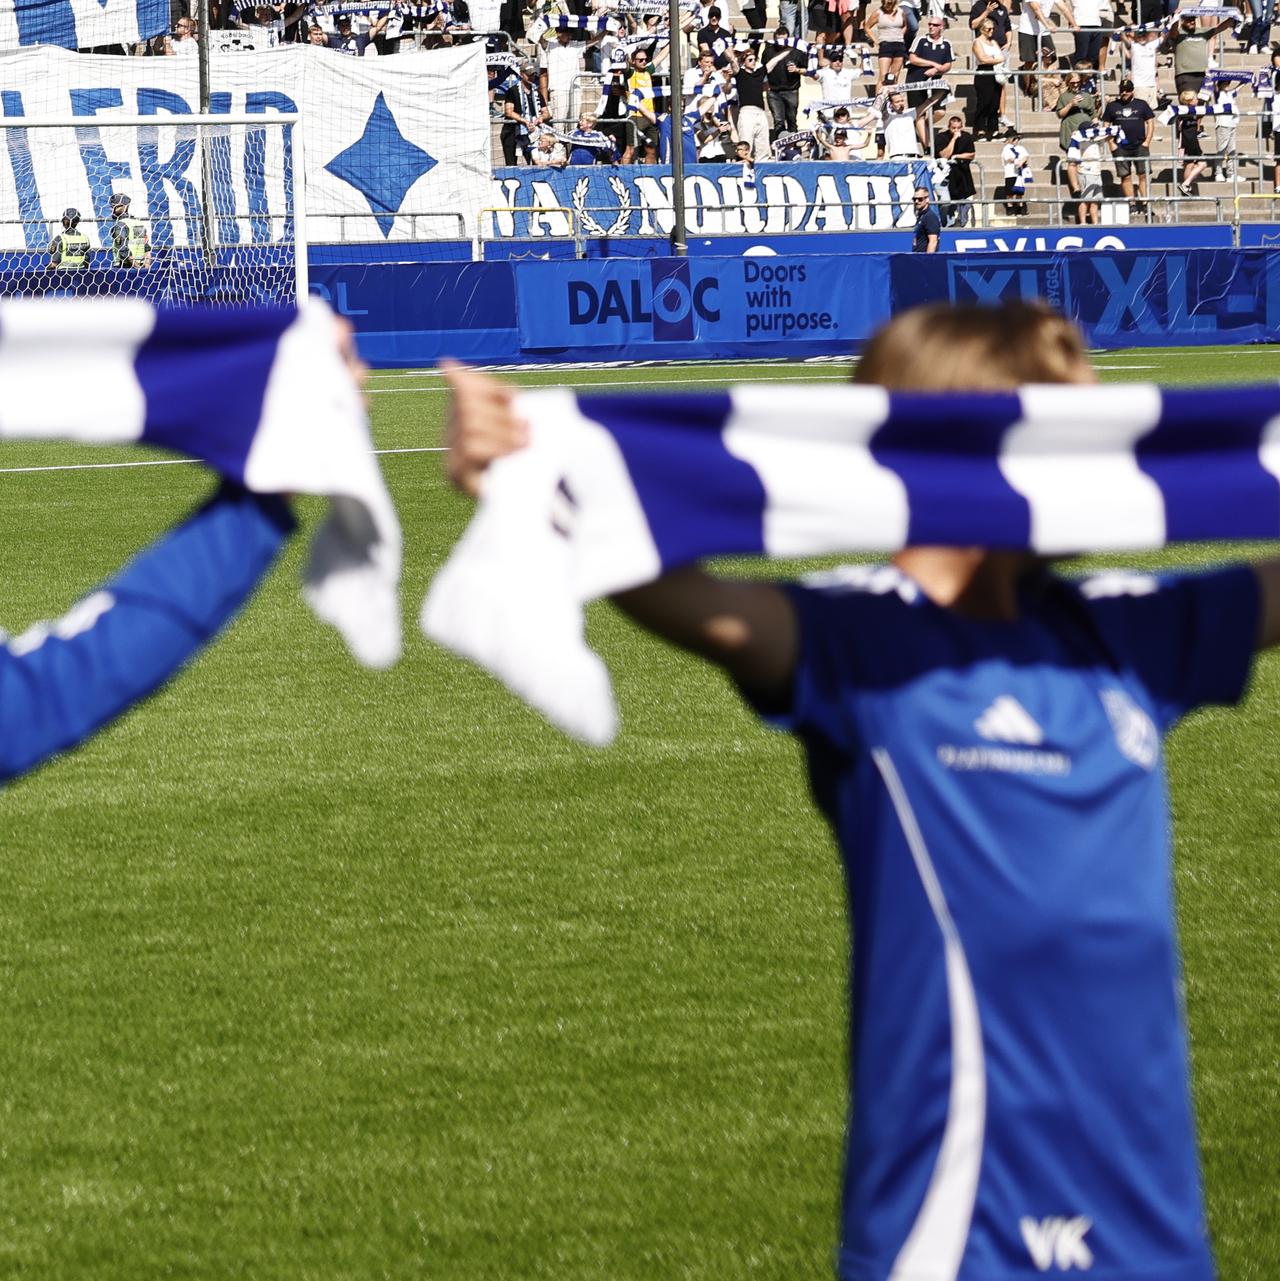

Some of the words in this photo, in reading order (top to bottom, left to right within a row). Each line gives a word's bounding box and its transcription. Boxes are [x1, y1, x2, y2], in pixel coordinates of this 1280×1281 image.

[339, 0, 389, 14] NORRKÖPING
[743, 260, 807, 284] Doors
[567, 276, 721, 326] DALOC
[746, 283, 792, 309] with
[746, 309, 840, 338] purpose.
[1019, 1214, 1095, 1272] VK
